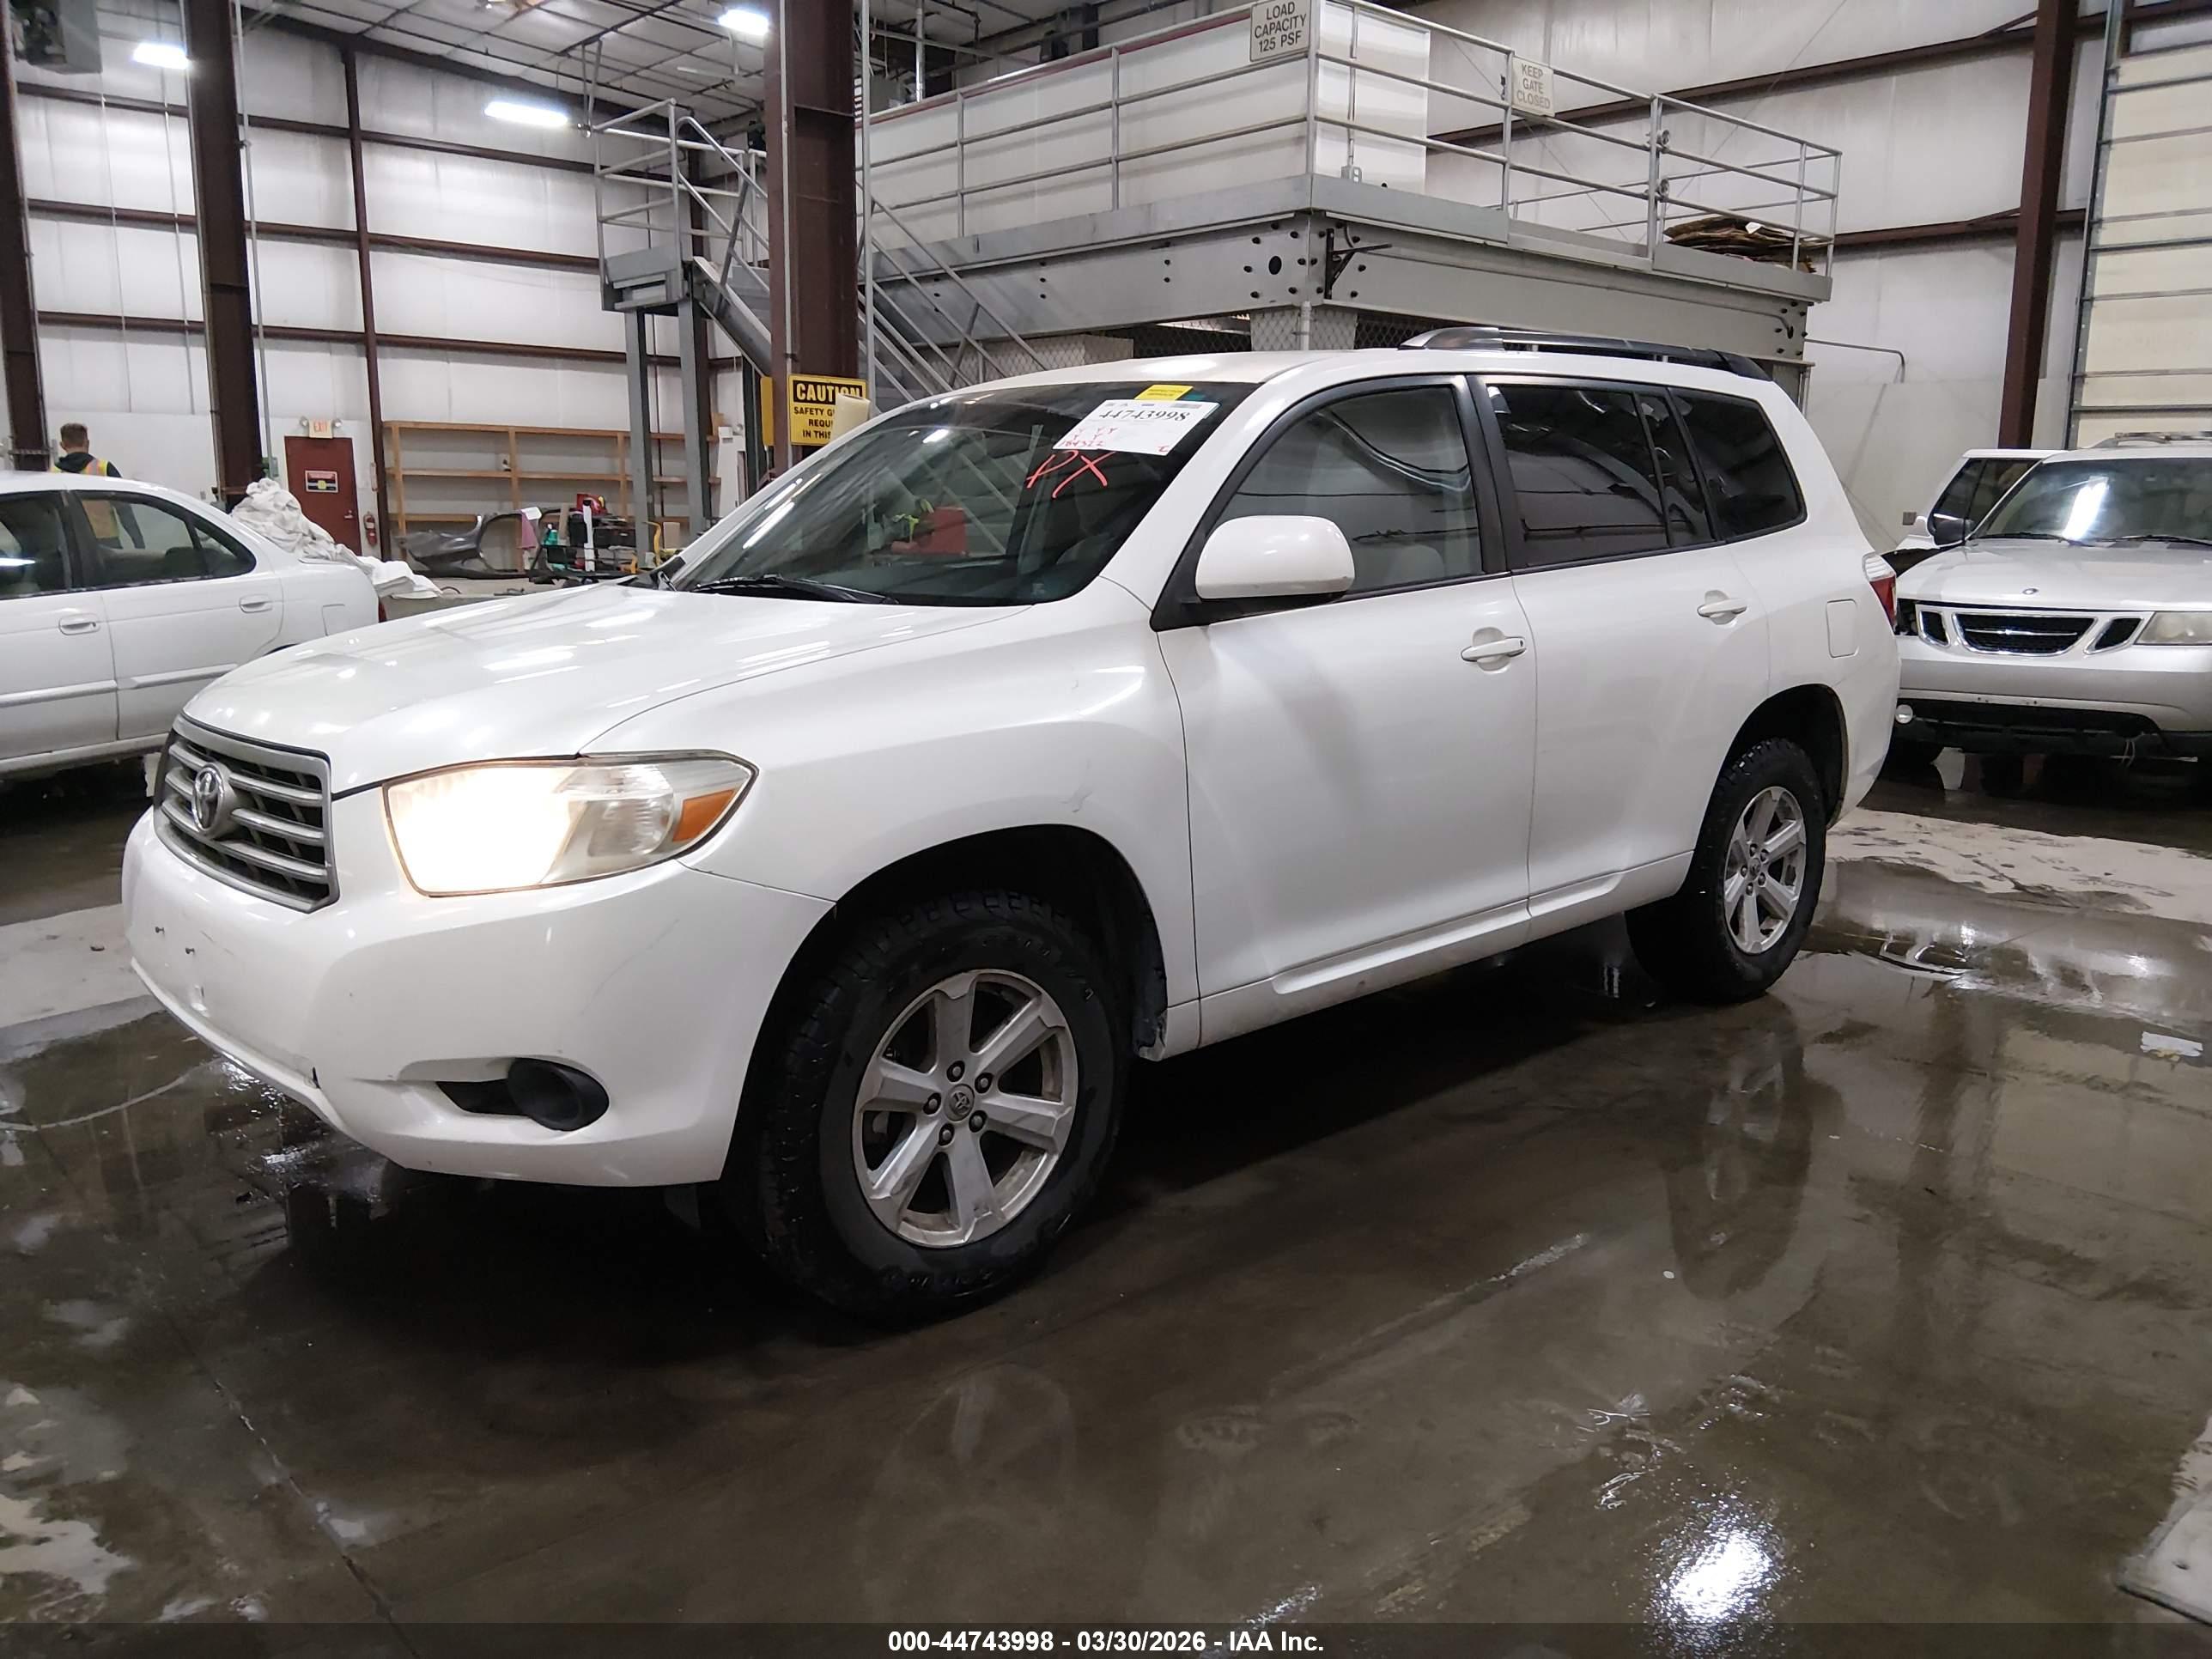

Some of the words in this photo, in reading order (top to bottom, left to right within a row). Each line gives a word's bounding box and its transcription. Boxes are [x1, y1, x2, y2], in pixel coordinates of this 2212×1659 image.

[1266, 1, 1295, 21] LOAD
[1254, 13, 1307, 39] CAPACITY
[1258, 37, 1276, 52] 125
[1280, 30, 1303, 46] PSF
[1521, 64, 1543, 79] KEEP
[1522, 78, 1544, 94] GATE
[1516, 89, 1551, 110] CLOSED
[796, 383, 860, 402] CAUTION
[793, 406, 824, 416] SAFETY
[1099, 410, 1190, 421] 44743998
[803, 429, 811, 438] IN
